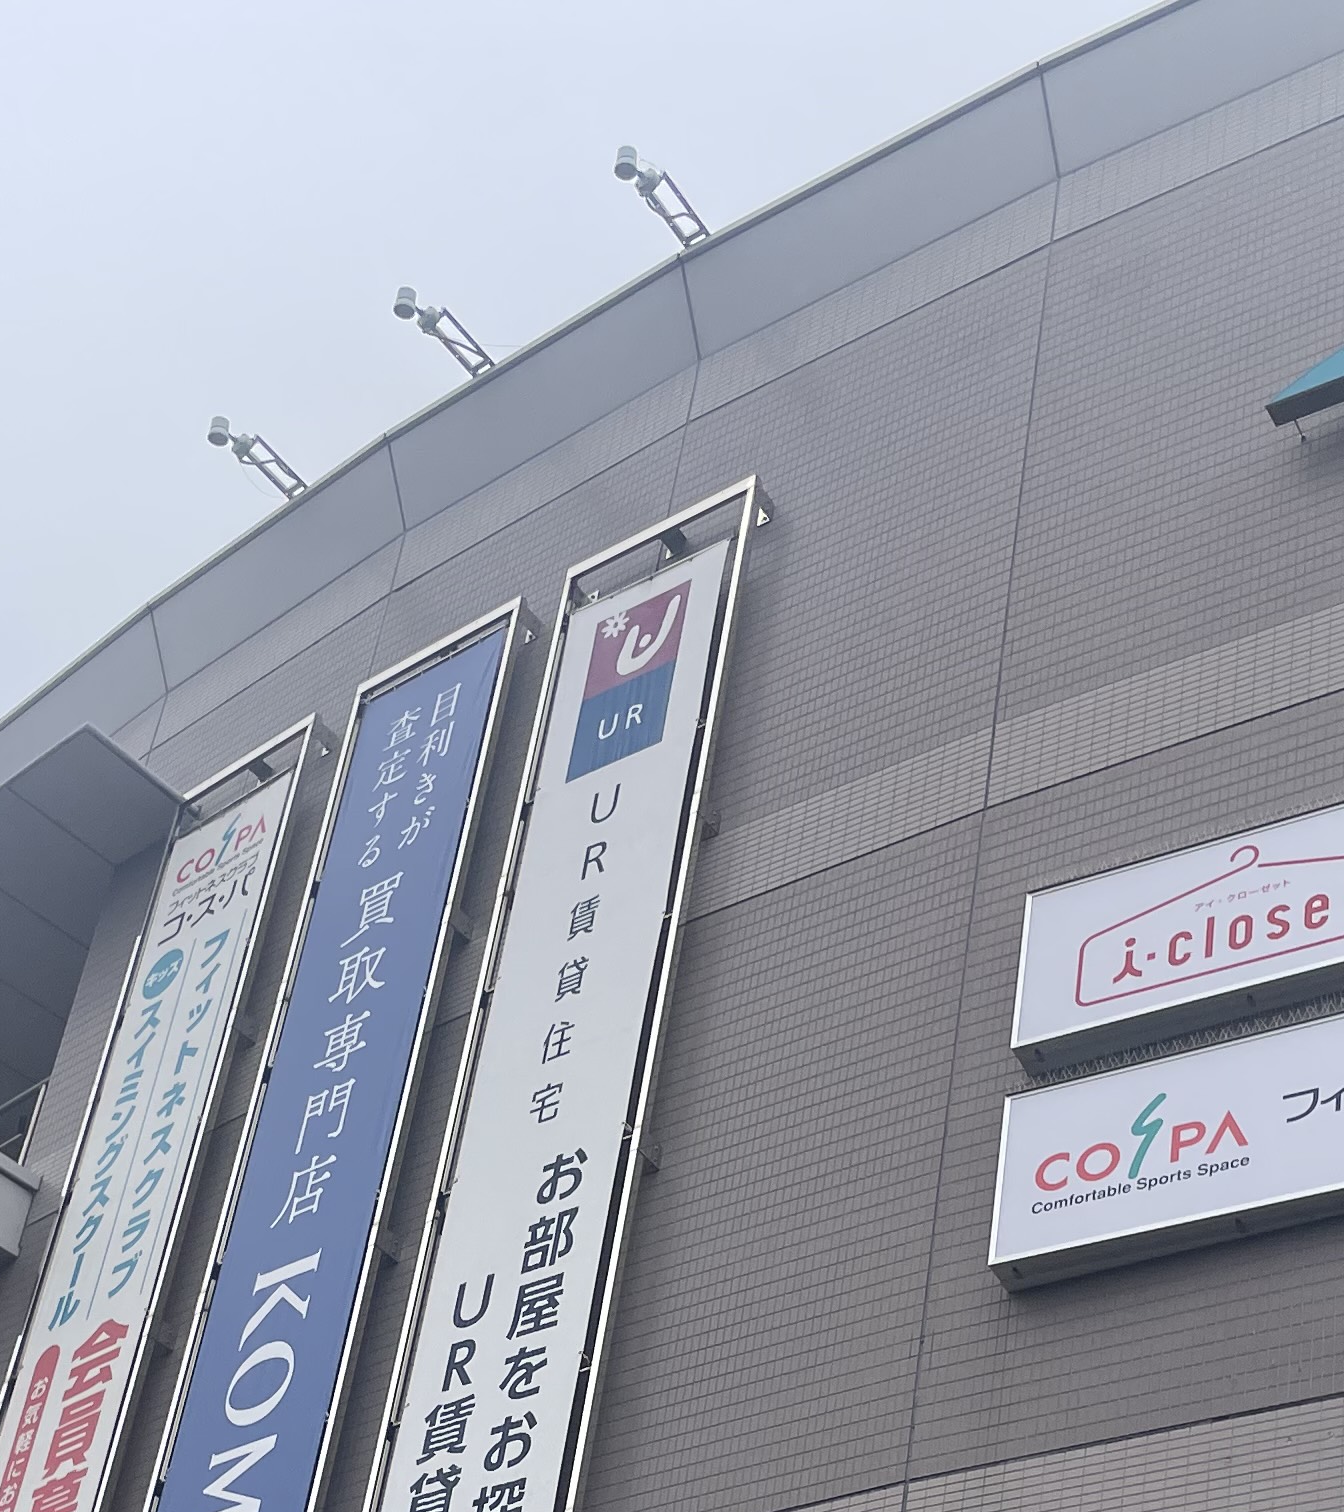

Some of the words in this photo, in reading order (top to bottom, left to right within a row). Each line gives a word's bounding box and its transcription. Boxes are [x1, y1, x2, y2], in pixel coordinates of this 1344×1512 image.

[357, 707, 424, 869] 査定する
[397, 682, 462, 851] 目利きが
[597, 703, 644, 741] UR
[177, 813, 267, 884] COSPA
[530, 783, 621, 1125] UR賃貸住宅
[106, 928, 231, 1300] フィットネスクラブ
[270, 871, 404, 1230] 買取専門店
[48, 1000, 162, 1332] スイミングスクール
[1031, 1184, 1132, 1215] Comfortable
[1136, 1169, 1192, 1191] Sports
[1197, 1156, 1251, 1177] Space
[1035, 1092, 1249, 1192] COSPA
